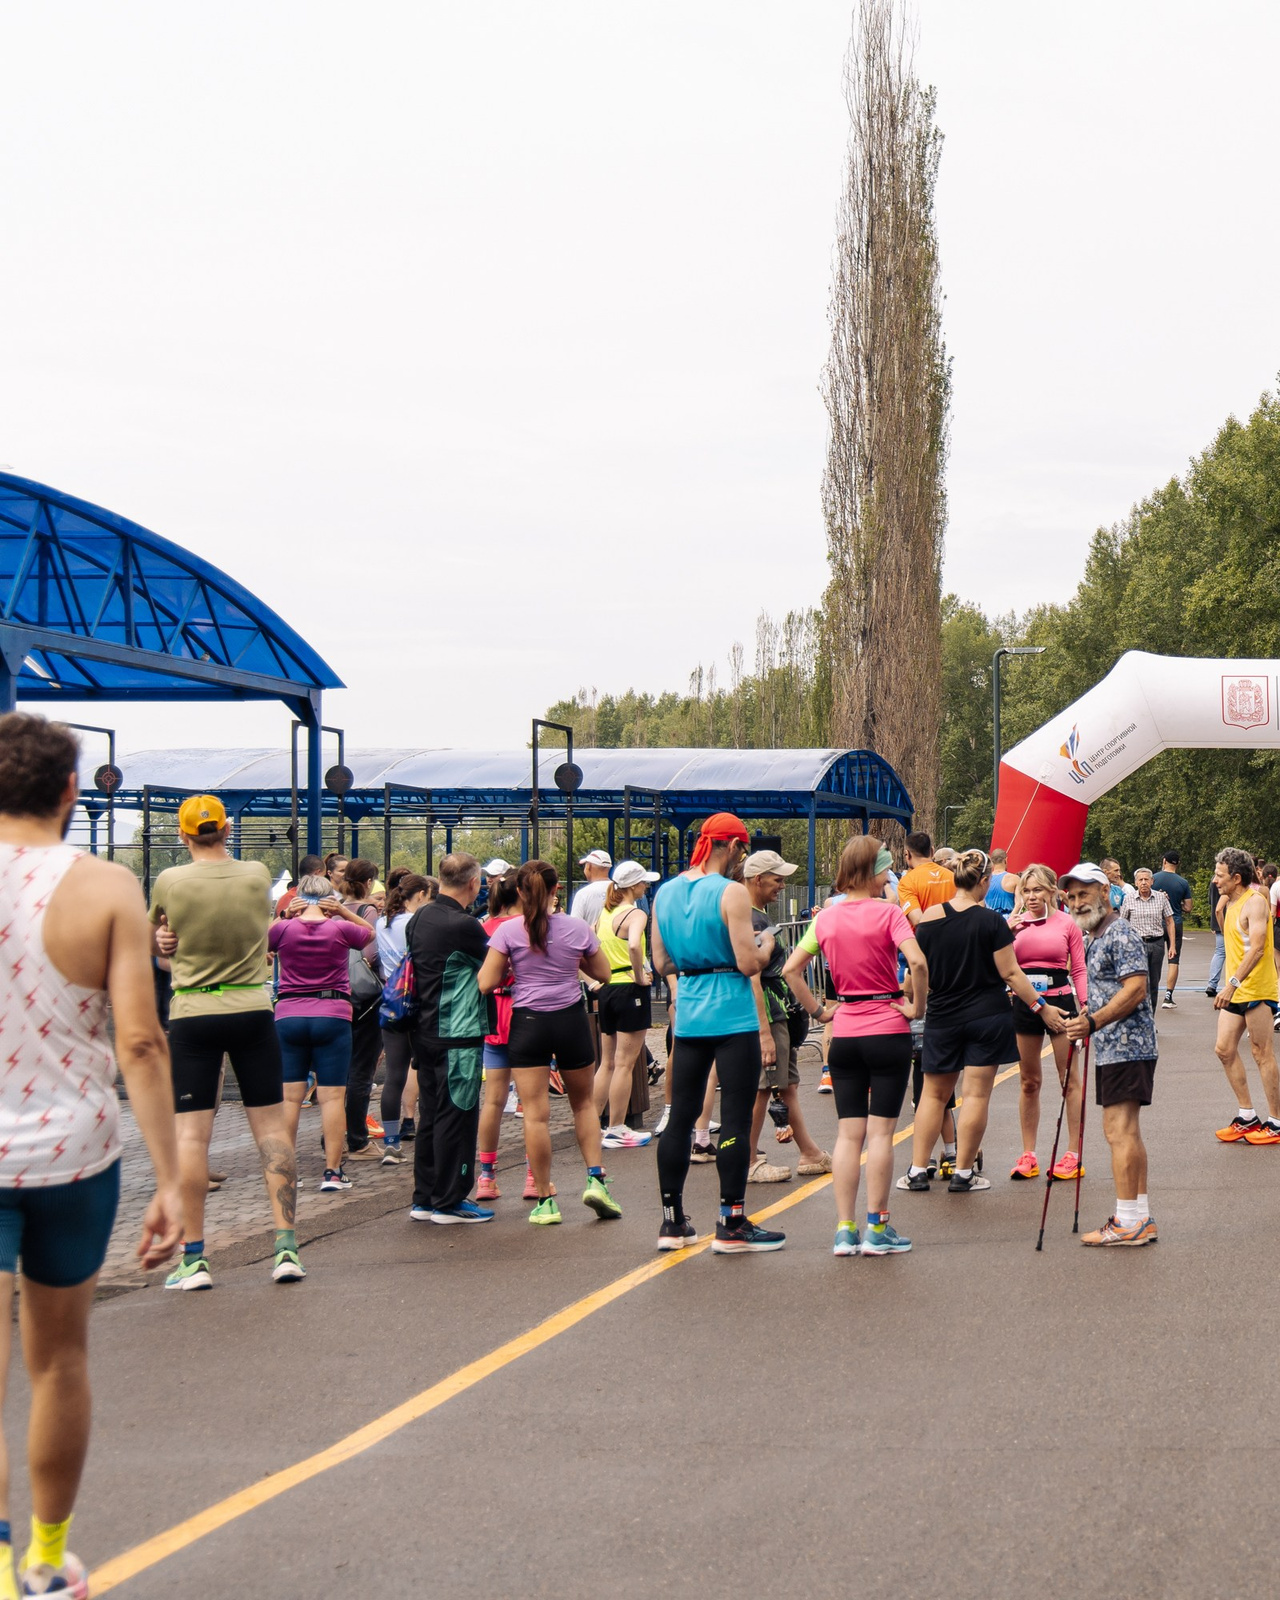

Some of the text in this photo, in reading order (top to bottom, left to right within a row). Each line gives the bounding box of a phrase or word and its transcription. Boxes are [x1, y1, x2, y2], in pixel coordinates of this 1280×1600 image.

[1088, 722, 1138, 763] ЦЕНТР СПОРТИВНОЙ
[1094, 743, 1127, 770] ПОДГОТОВКИ
